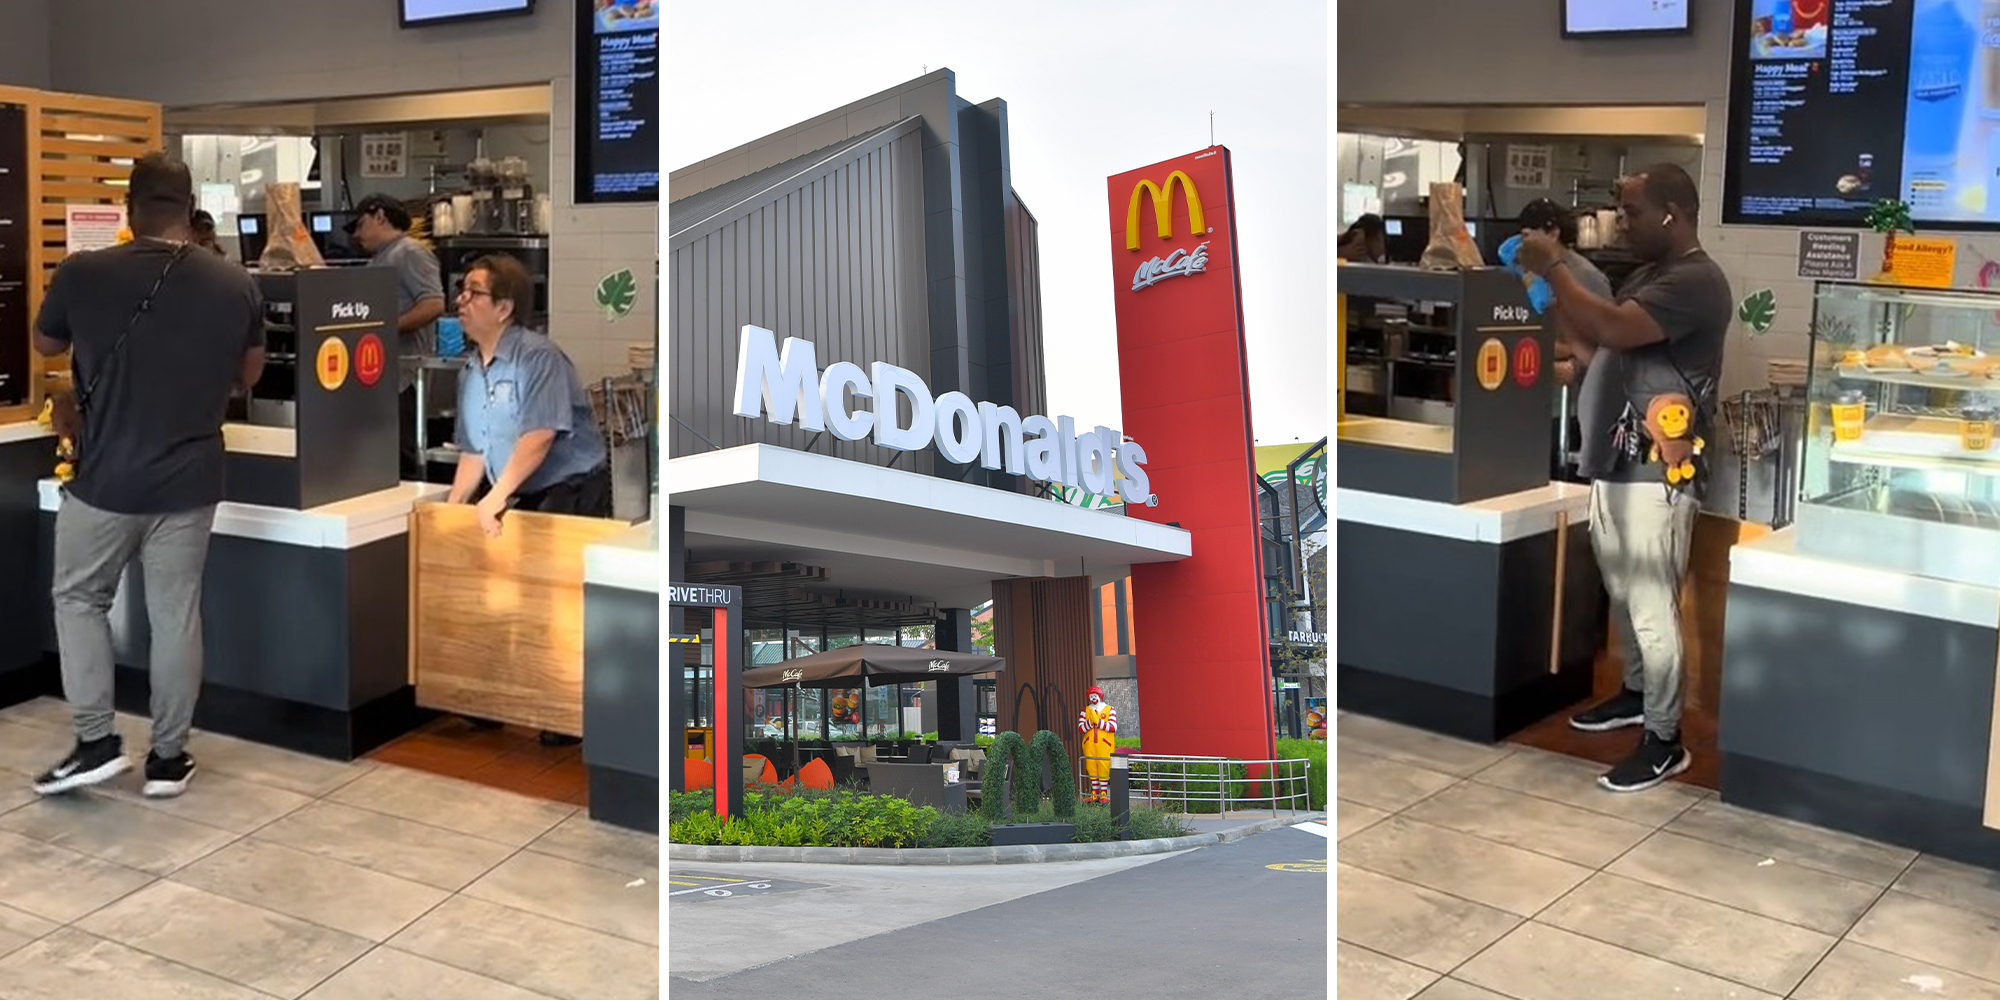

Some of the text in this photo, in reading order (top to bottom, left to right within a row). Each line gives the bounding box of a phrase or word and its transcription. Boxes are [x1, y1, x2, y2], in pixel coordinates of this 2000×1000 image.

[601, 36, 630, 50] Happy
[1755, 64, 1784, 76] Happy
[1807, 232, 1852, 242] Customers
[1915, 244, 1954, 255] Allergy?
[1806, 251, 1851, 260] Assistance
[1803, 259, 1829, 268] Please
[1801, 267, 1854, 277] Crew Member
[331, 302, 370, 320] Pick Up
[1493, 305, 1529, 323] Pick Up
[733, 324, 1150, 505] McDonald's
